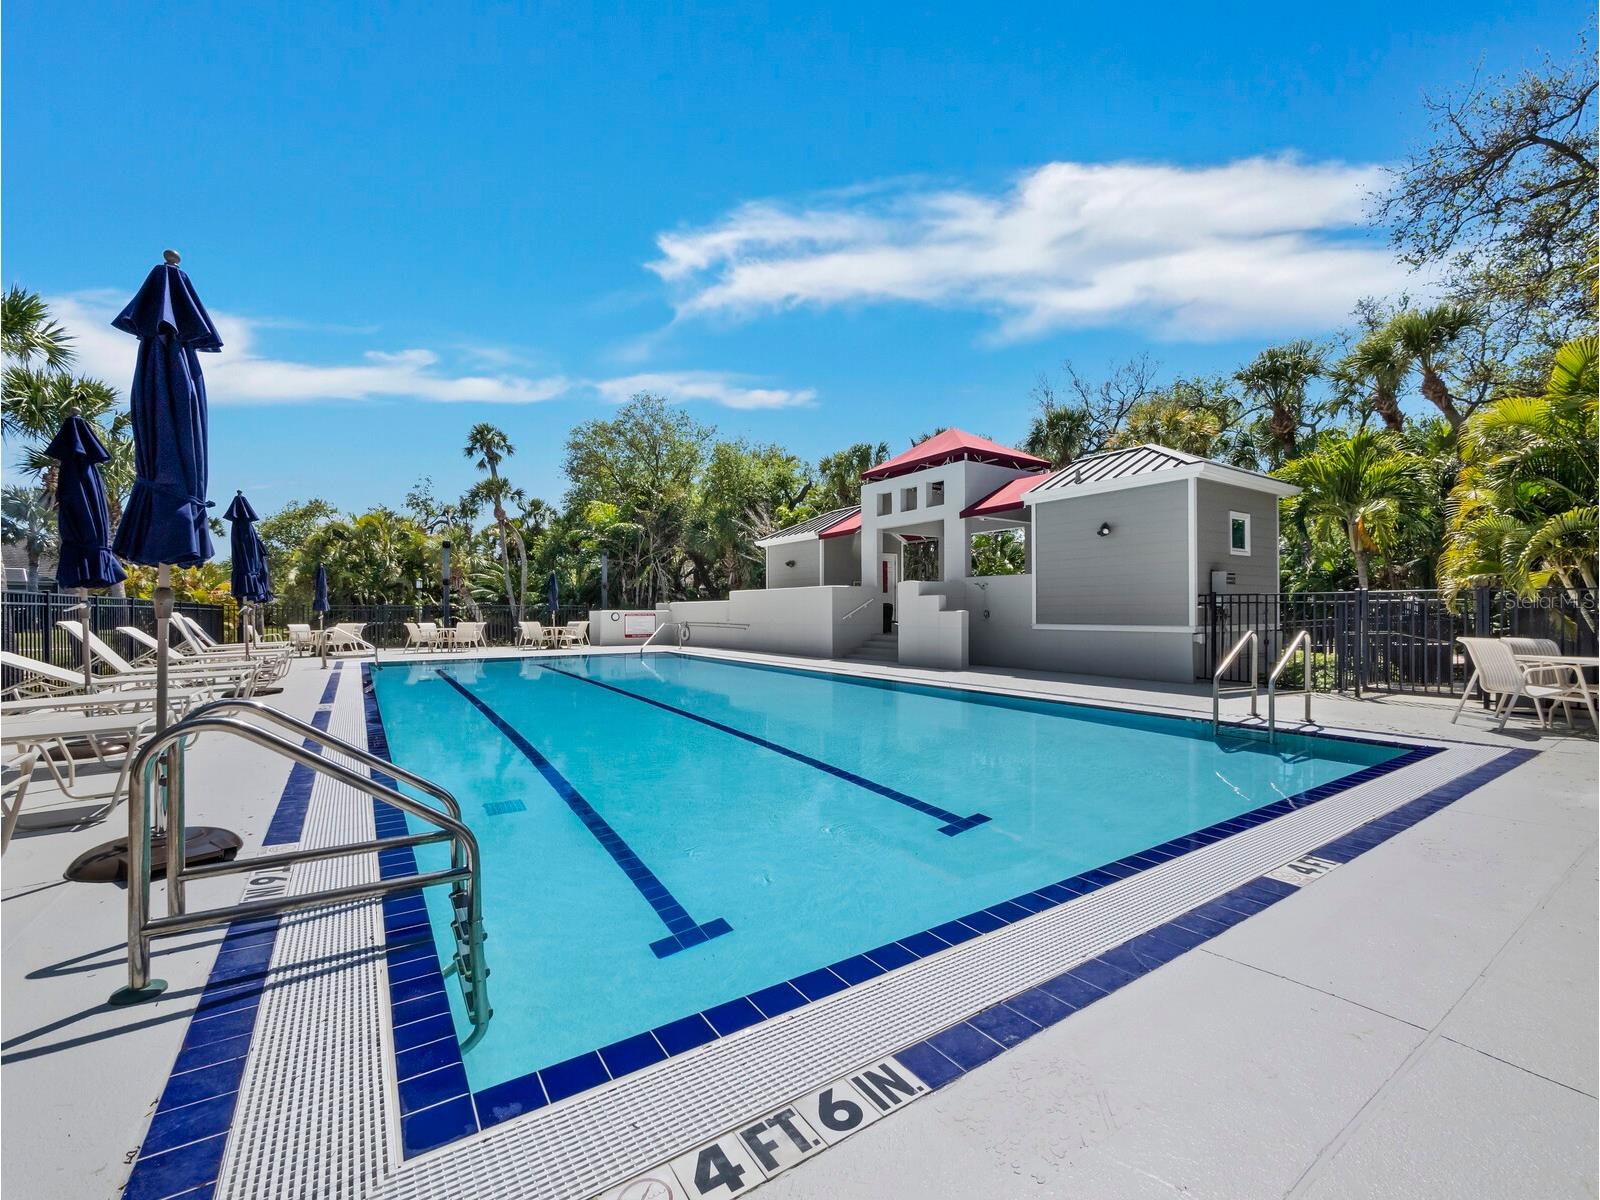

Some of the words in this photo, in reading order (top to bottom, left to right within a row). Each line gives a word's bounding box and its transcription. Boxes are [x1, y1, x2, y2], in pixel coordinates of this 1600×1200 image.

[694, 1143, 746, 1195] 4
[739, 1107, 821, 1172] FT.
[818, 1087, 864, 1132] 6
[850, 1062, 925, 1112] IN.
